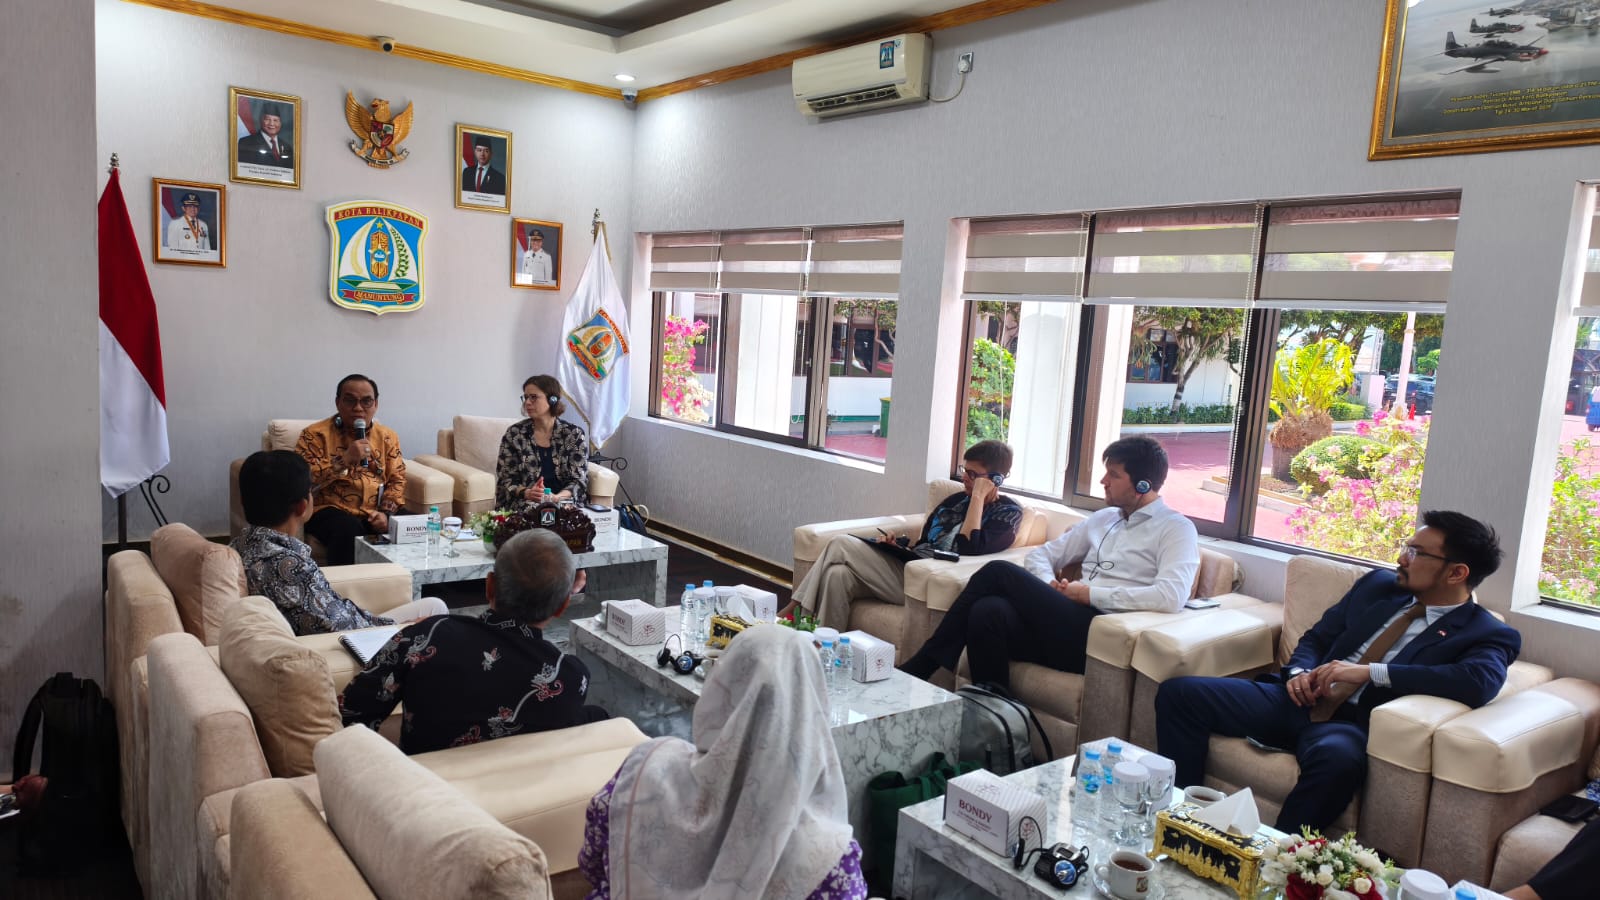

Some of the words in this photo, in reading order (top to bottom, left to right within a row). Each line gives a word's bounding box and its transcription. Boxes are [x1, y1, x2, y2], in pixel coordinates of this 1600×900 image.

[338, 207, 363, 219] KOTA
[366, 207, 420, 226] BALIKPAPAN
[959, 799, 992, 823] BONDY
